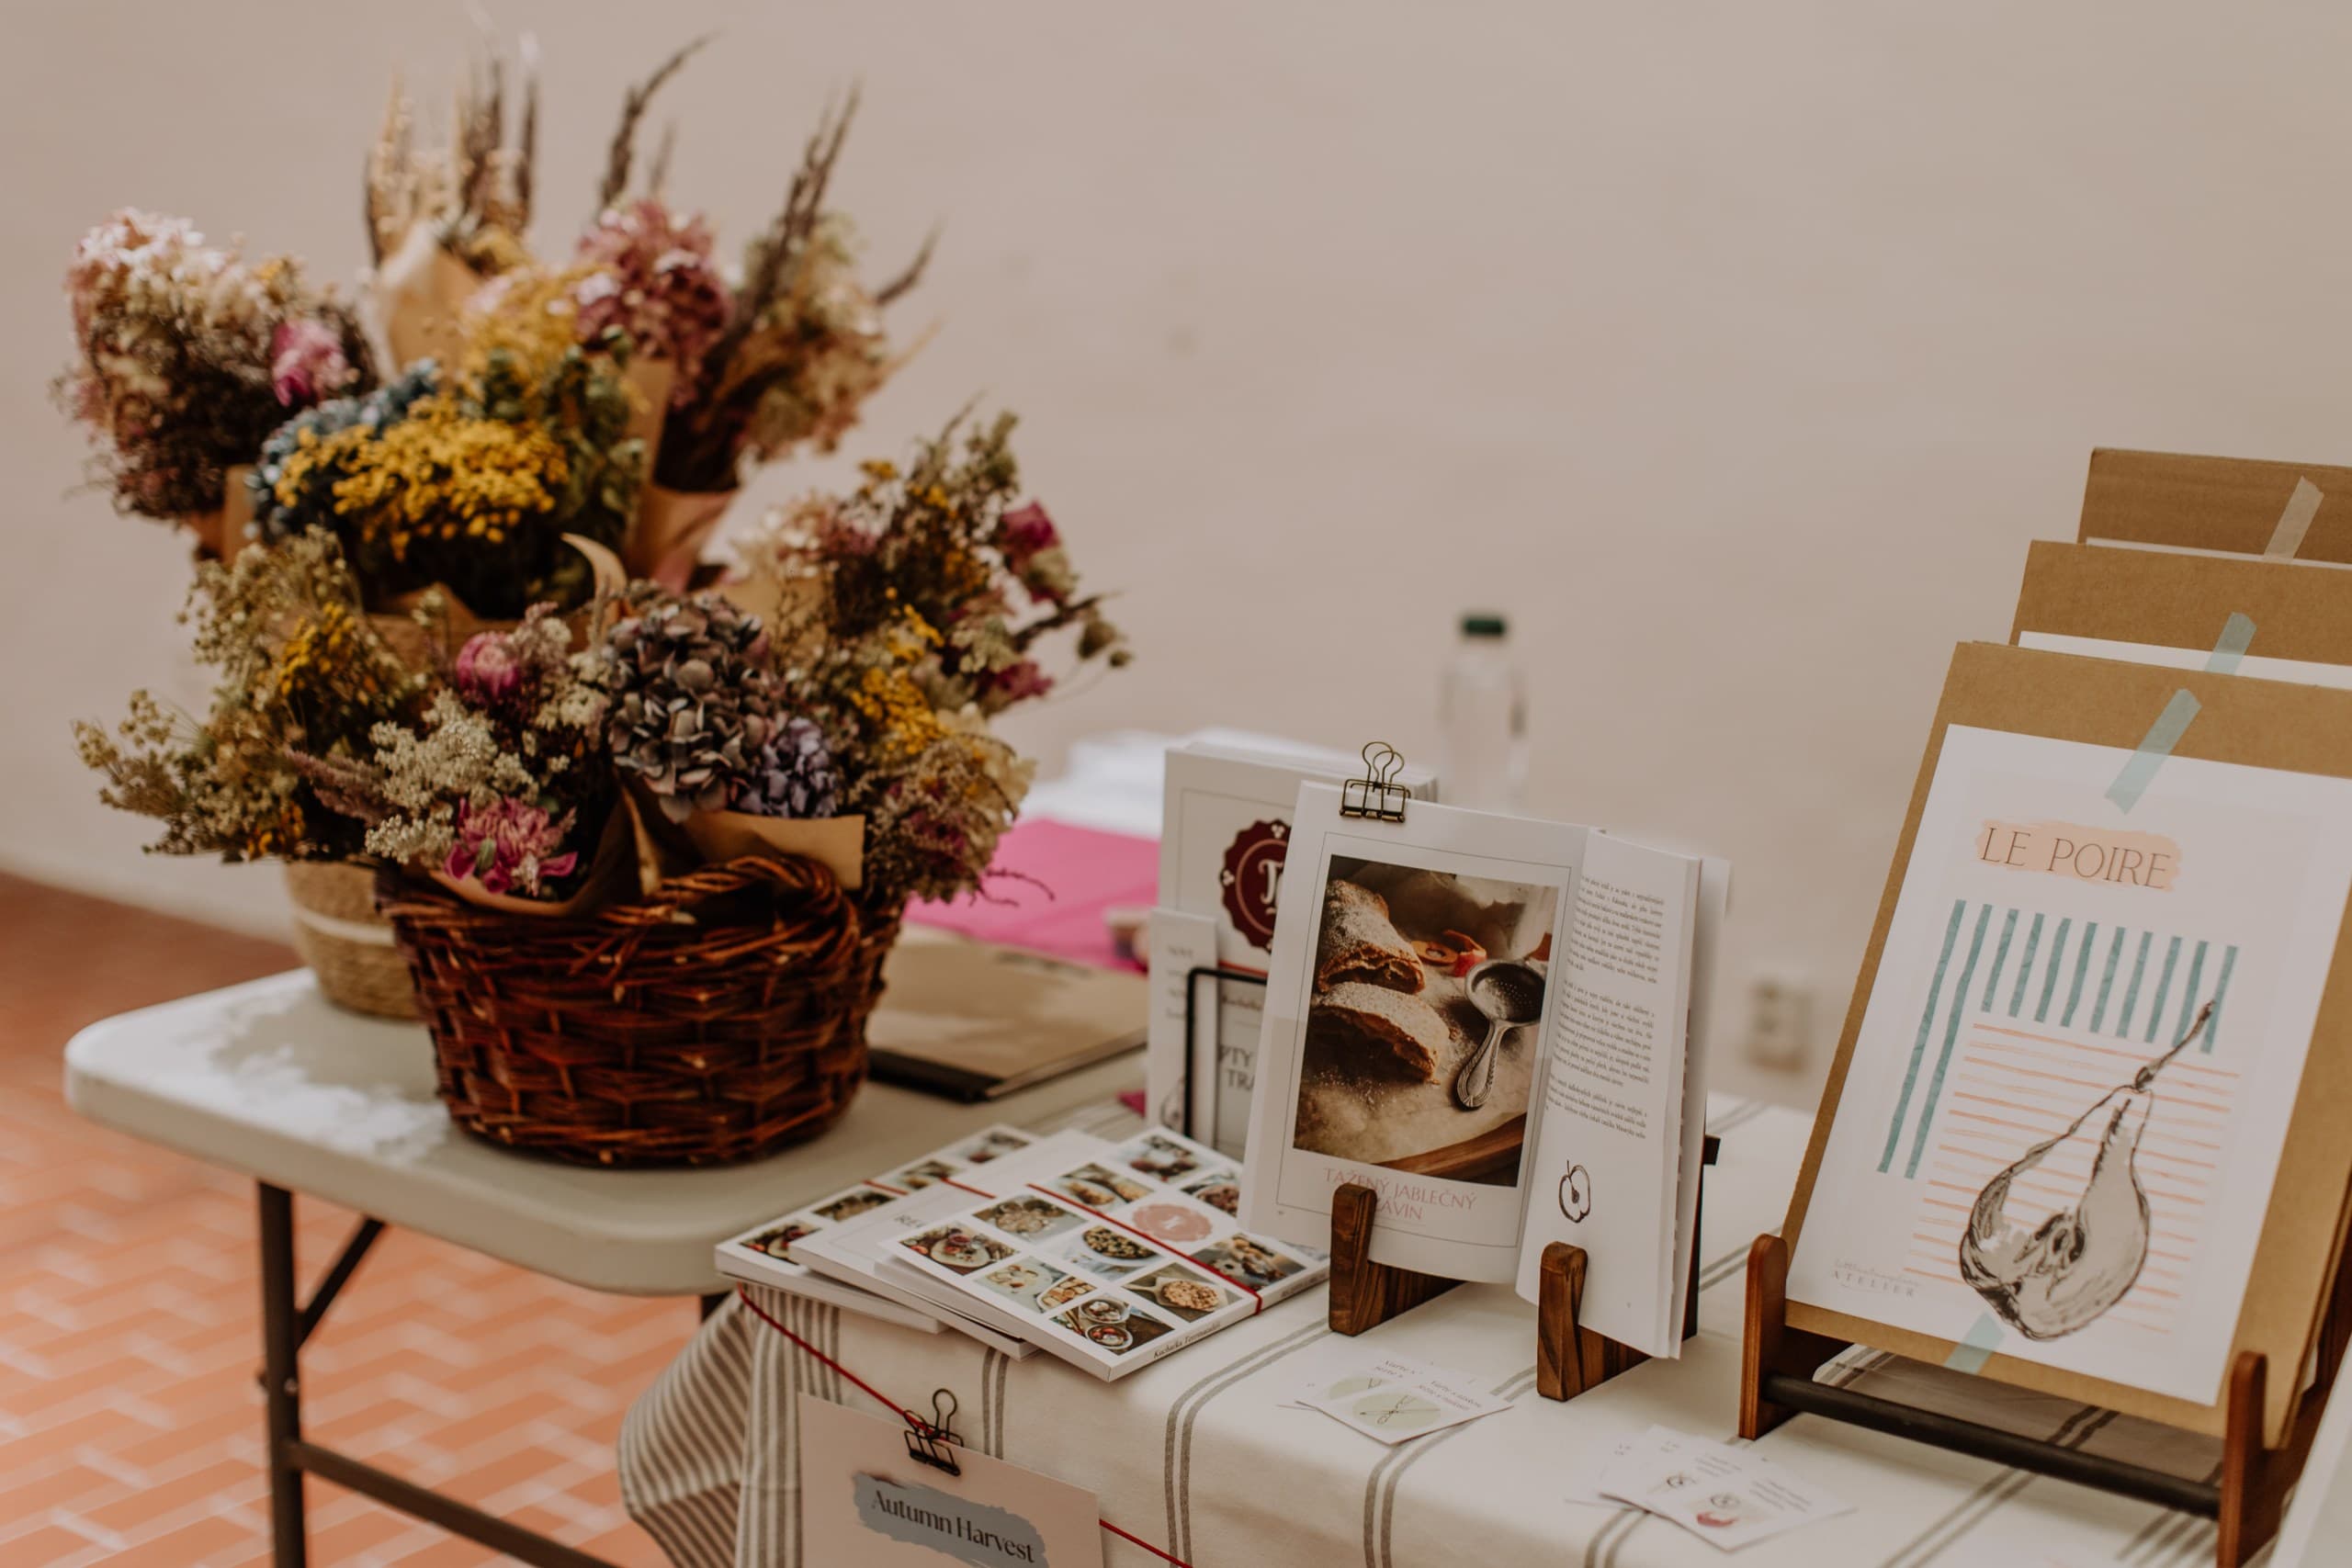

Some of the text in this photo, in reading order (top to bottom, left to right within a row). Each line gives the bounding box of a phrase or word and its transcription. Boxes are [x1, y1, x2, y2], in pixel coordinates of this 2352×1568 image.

[1981, 828, 2171, 889] LE POIRE
[1393, 1181, 1476, 1210] JABLEČNÝ
[873, 1489, 1035, 1563] Autumn Harvest
